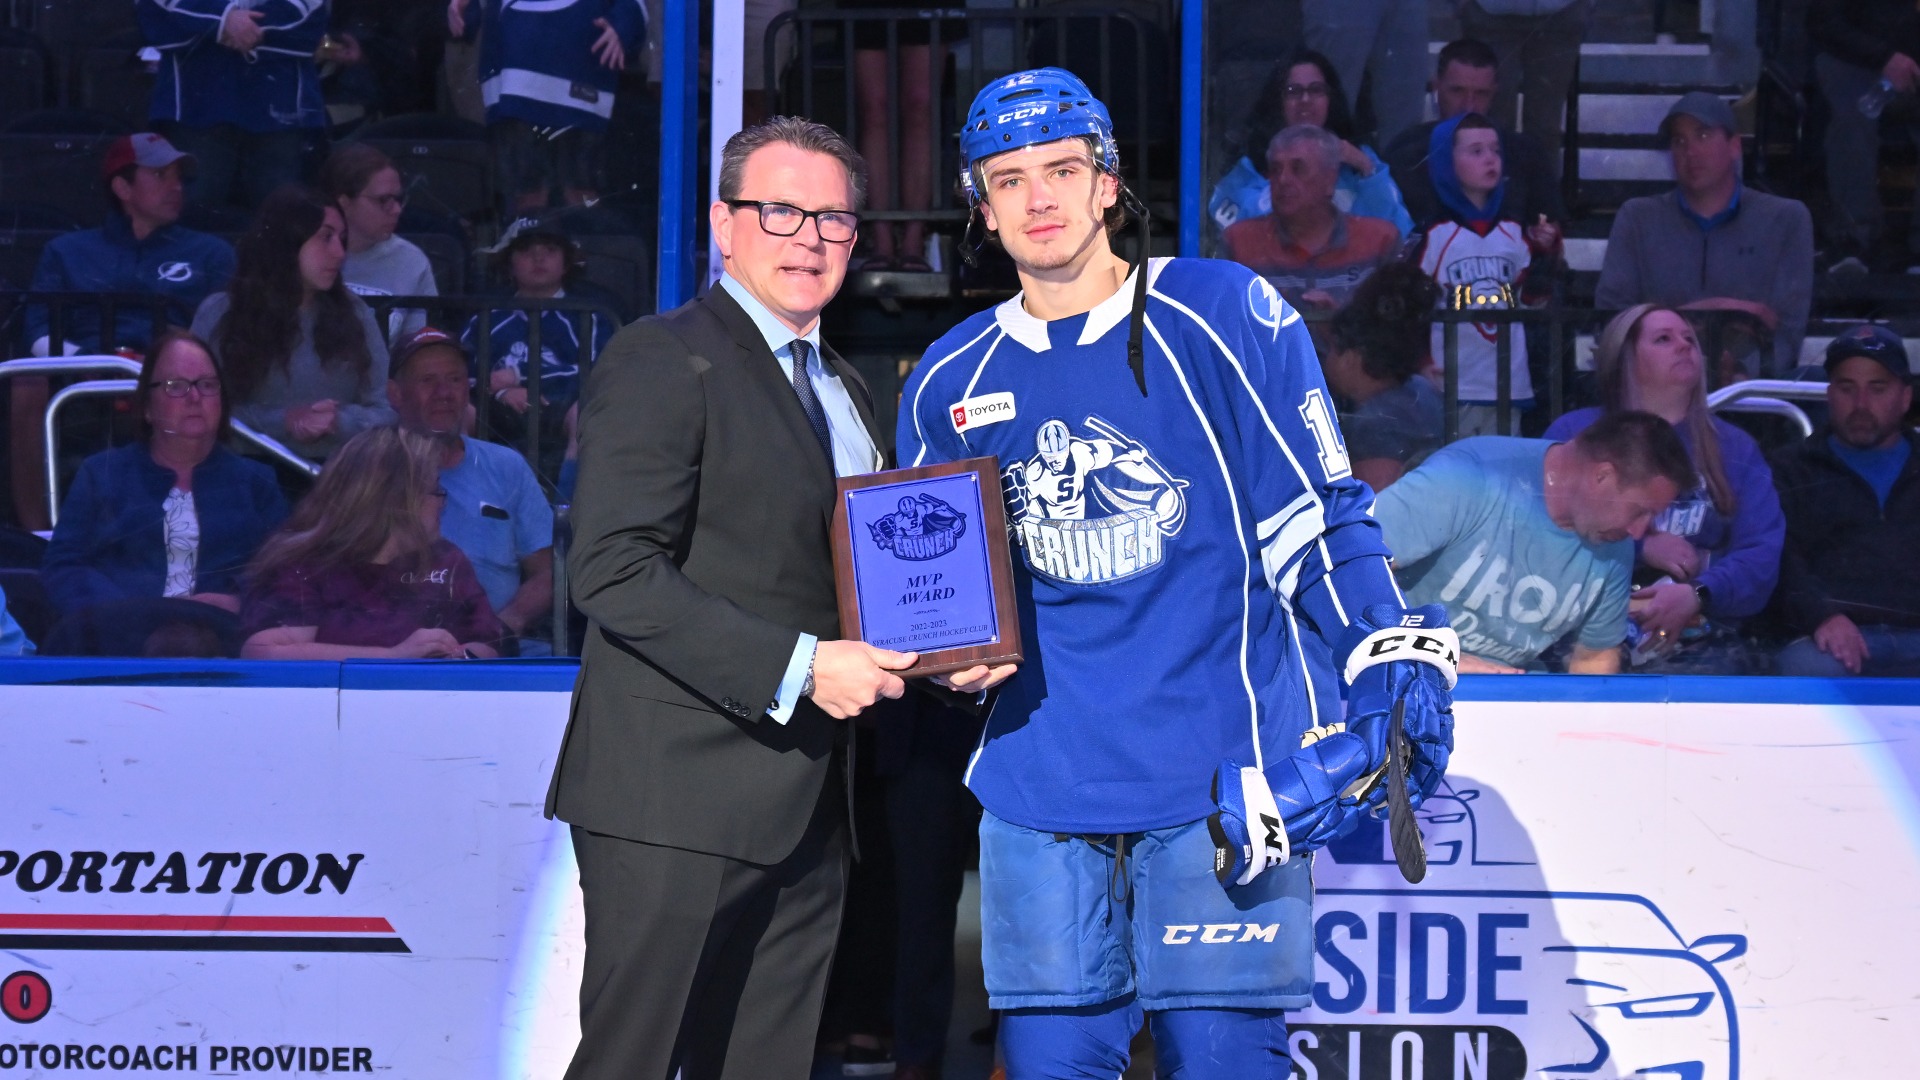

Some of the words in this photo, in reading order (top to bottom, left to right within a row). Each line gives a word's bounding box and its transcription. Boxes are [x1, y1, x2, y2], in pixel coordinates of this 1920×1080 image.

[1004, 74, 1034, 89] 12
[998, 106, 1047, 124] CCM
[1447, 256, 1516, 285] CRUNC
[968, 402, 1011, 417] TOYOTA
[1298, 388, 1352, 483] 1
[1056, 477, 1075, 503] S
[894, 530, 954, 559] CRUNCH
[1022, 511, 1163, 582] CRUNCH
[906, 572, 943, 589] MVP
[896, 587, 955, 606] AWARD
[910, 619, 948, 632] 2022-2023
[1400, 614, 1424, 627] 12
[872, 635, 907, 646] SYRACUSE
[908, 630, 938, 642] CRUNCH
[939, 626, 968, 638] HOCKEY
[969, 624, 989, 634] CLUB
[1162, 923, 1281, 945] CCM
[1312, 910, 1529, 1015] SIDE
[0, 1043, 197, 1071] OTORCOACH
[209, 1045, 374, 1072] PROVIDER
